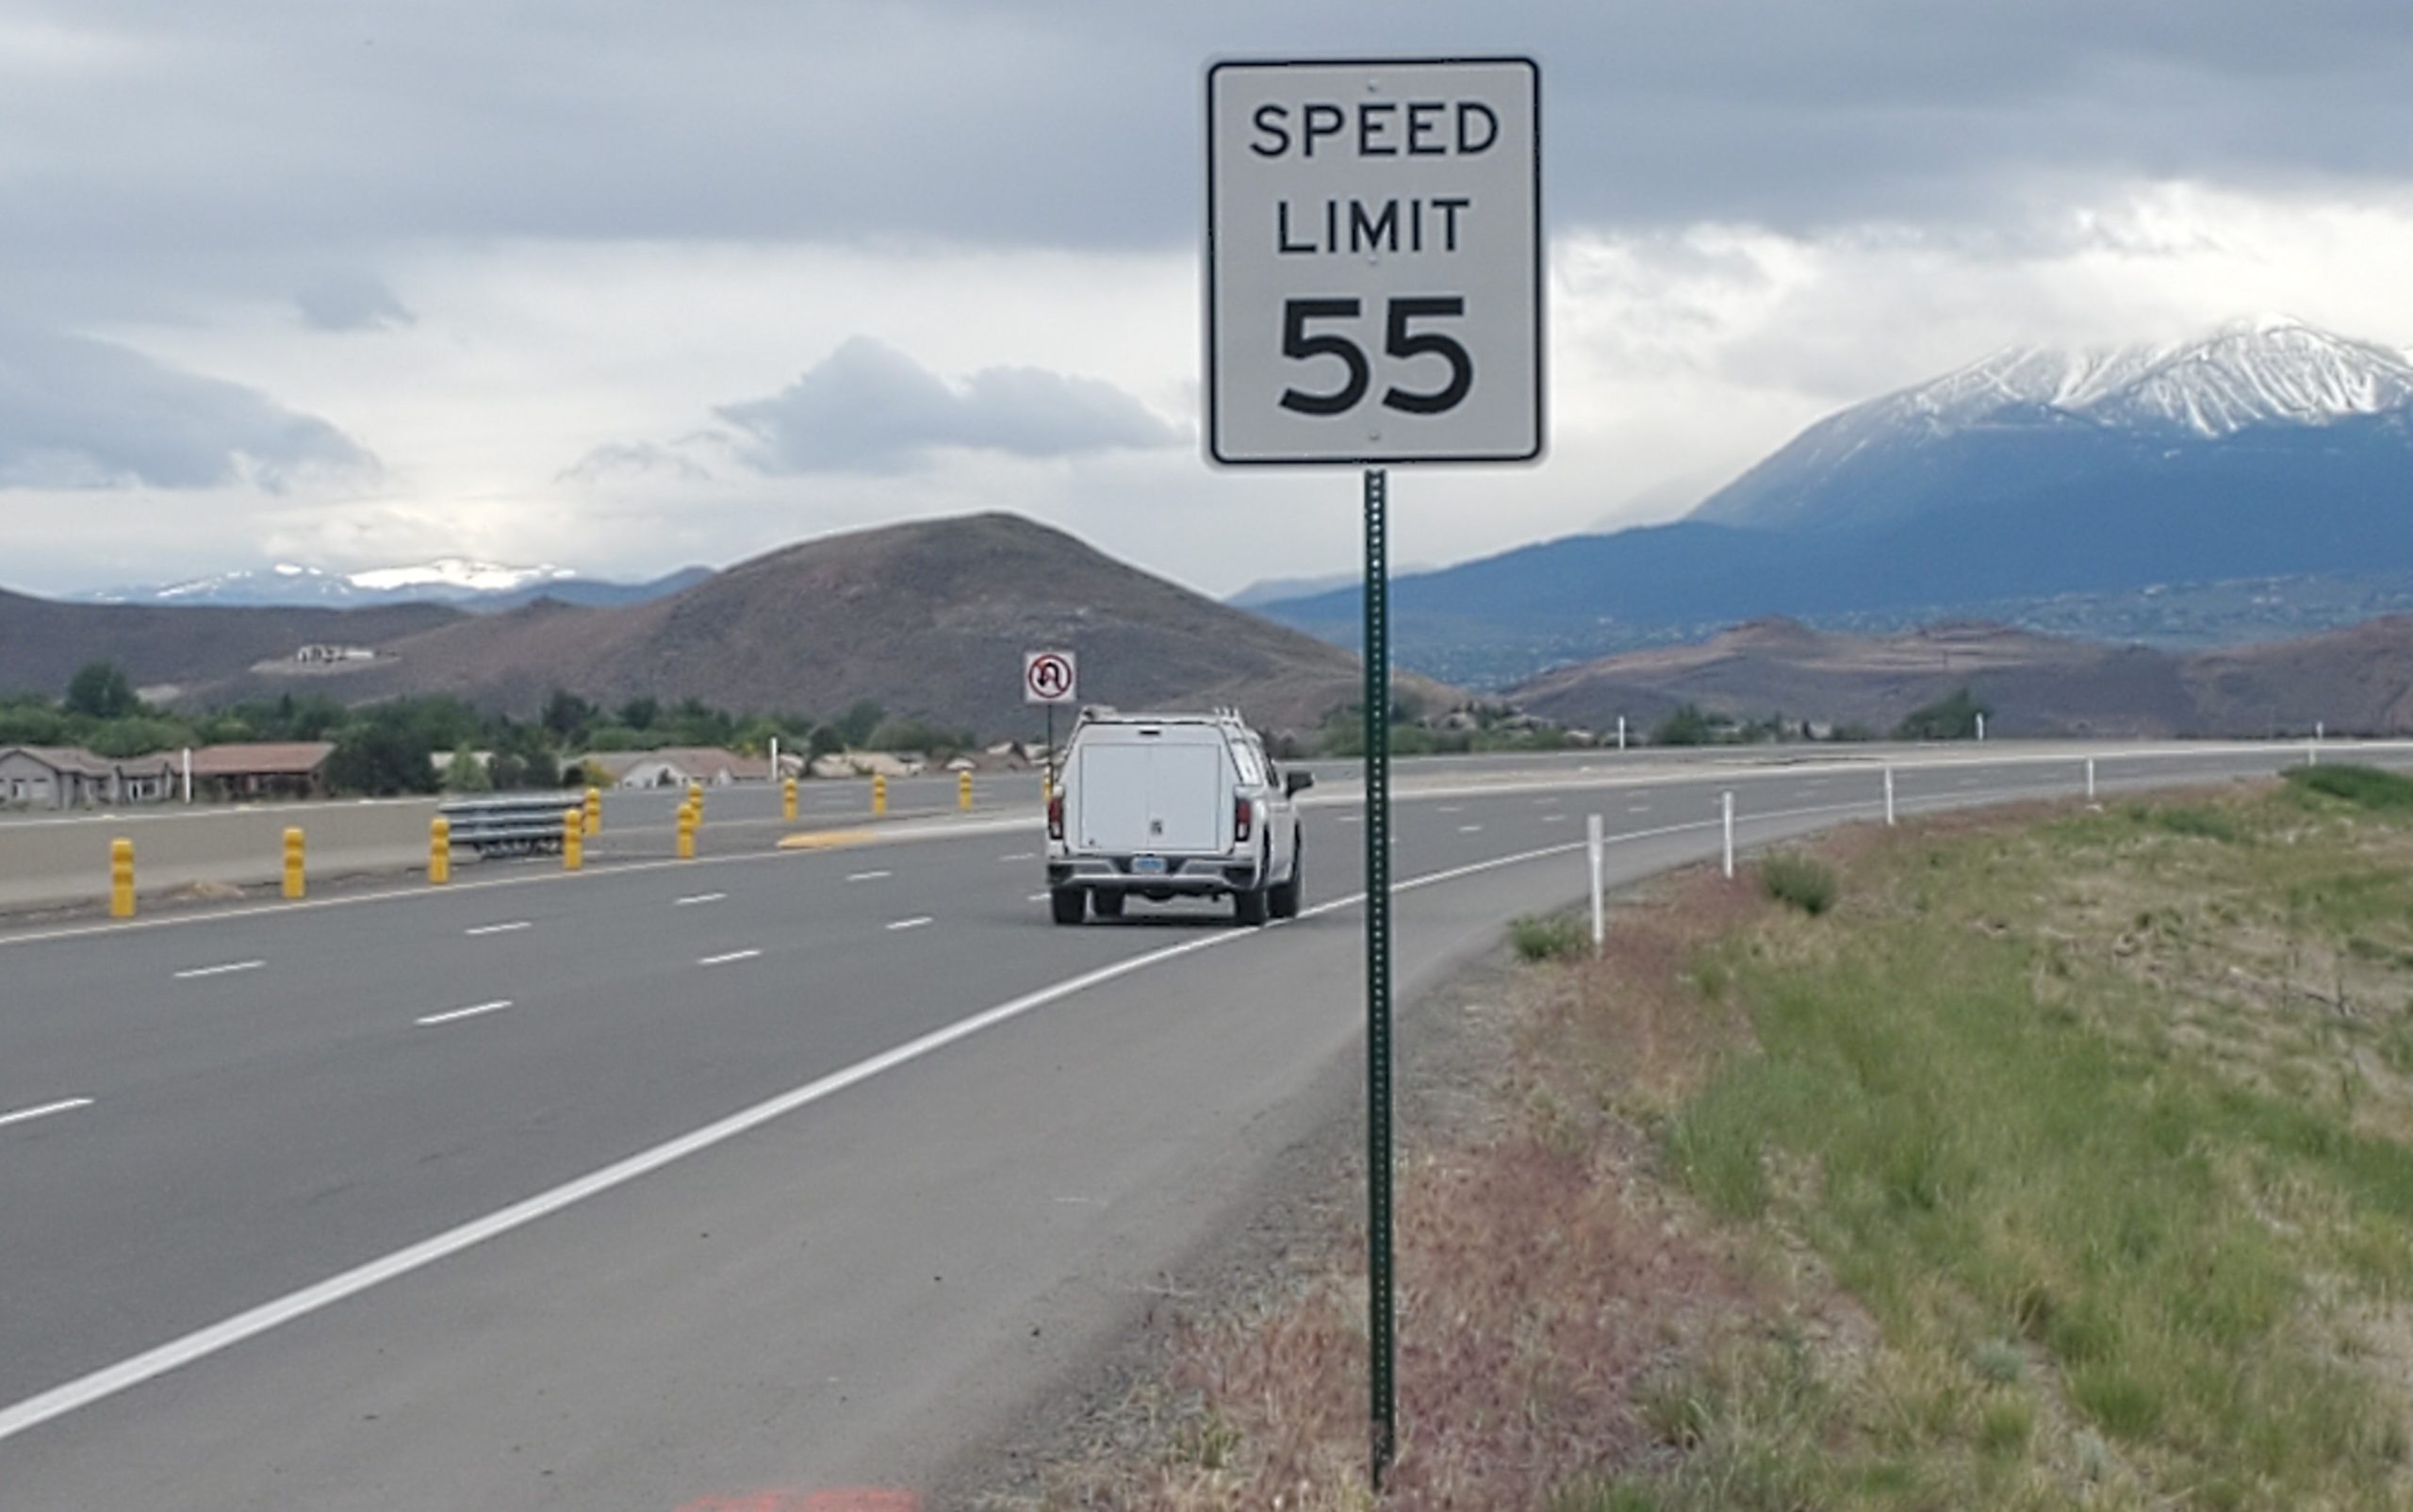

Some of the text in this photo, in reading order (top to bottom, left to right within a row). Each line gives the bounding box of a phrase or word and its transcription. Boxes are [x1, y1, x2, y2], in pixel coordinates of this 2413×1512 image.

[1249, 102, 1499, 158] SPEED
[1277, 198, 1470, 254] LIMIT
[1278, 296, 1474, 417] 55
